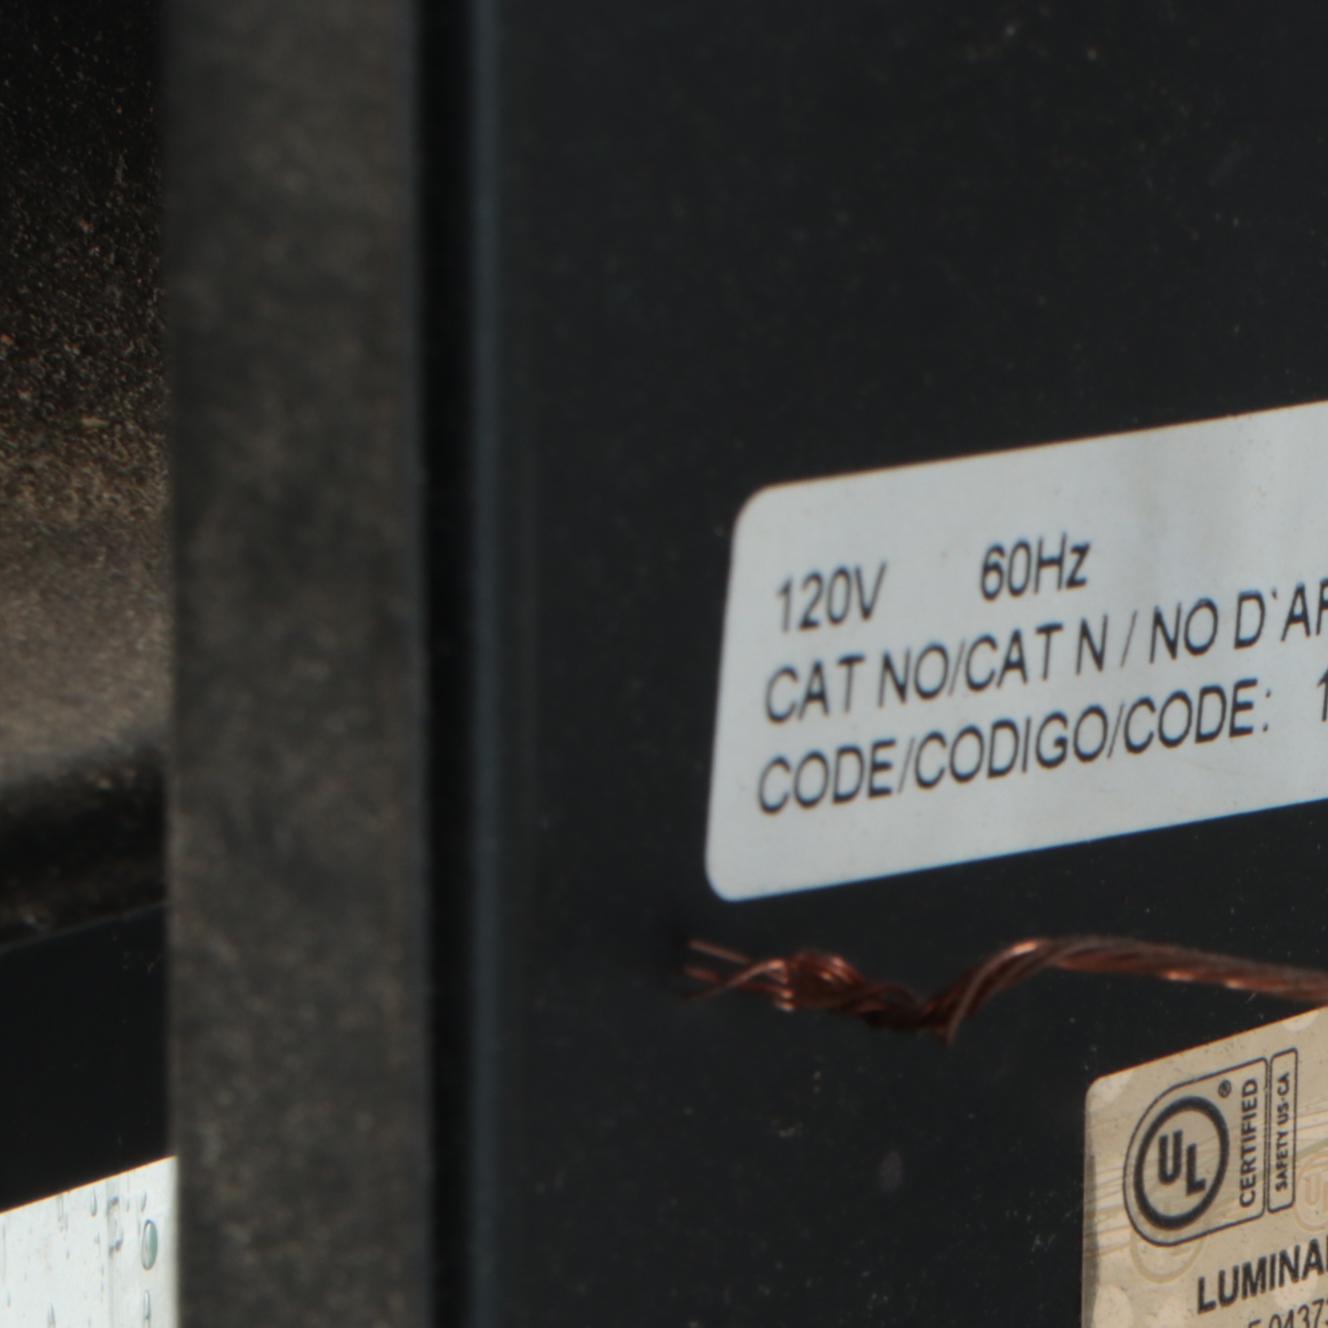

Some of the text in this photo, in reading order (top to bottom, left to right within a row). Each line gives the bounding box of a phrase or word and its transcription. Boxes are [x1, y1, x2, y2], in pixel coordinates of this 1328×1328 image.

[776, 532, 1091, 633] 120V 60Hz
[765, 653, 866, 724] CAT
[878, 622, 1063, 709] NO/CAT
[1150, 598, 1219, 664] NO
[757, 677, 1273, 815] CODE/CODIGO/CODE:
[1158, 1128, 1206, 1197] UL
[1239, 1078, 1259, 1208] CERTIFIED
[1275, 1130, 1290, 1192] SAFETY
